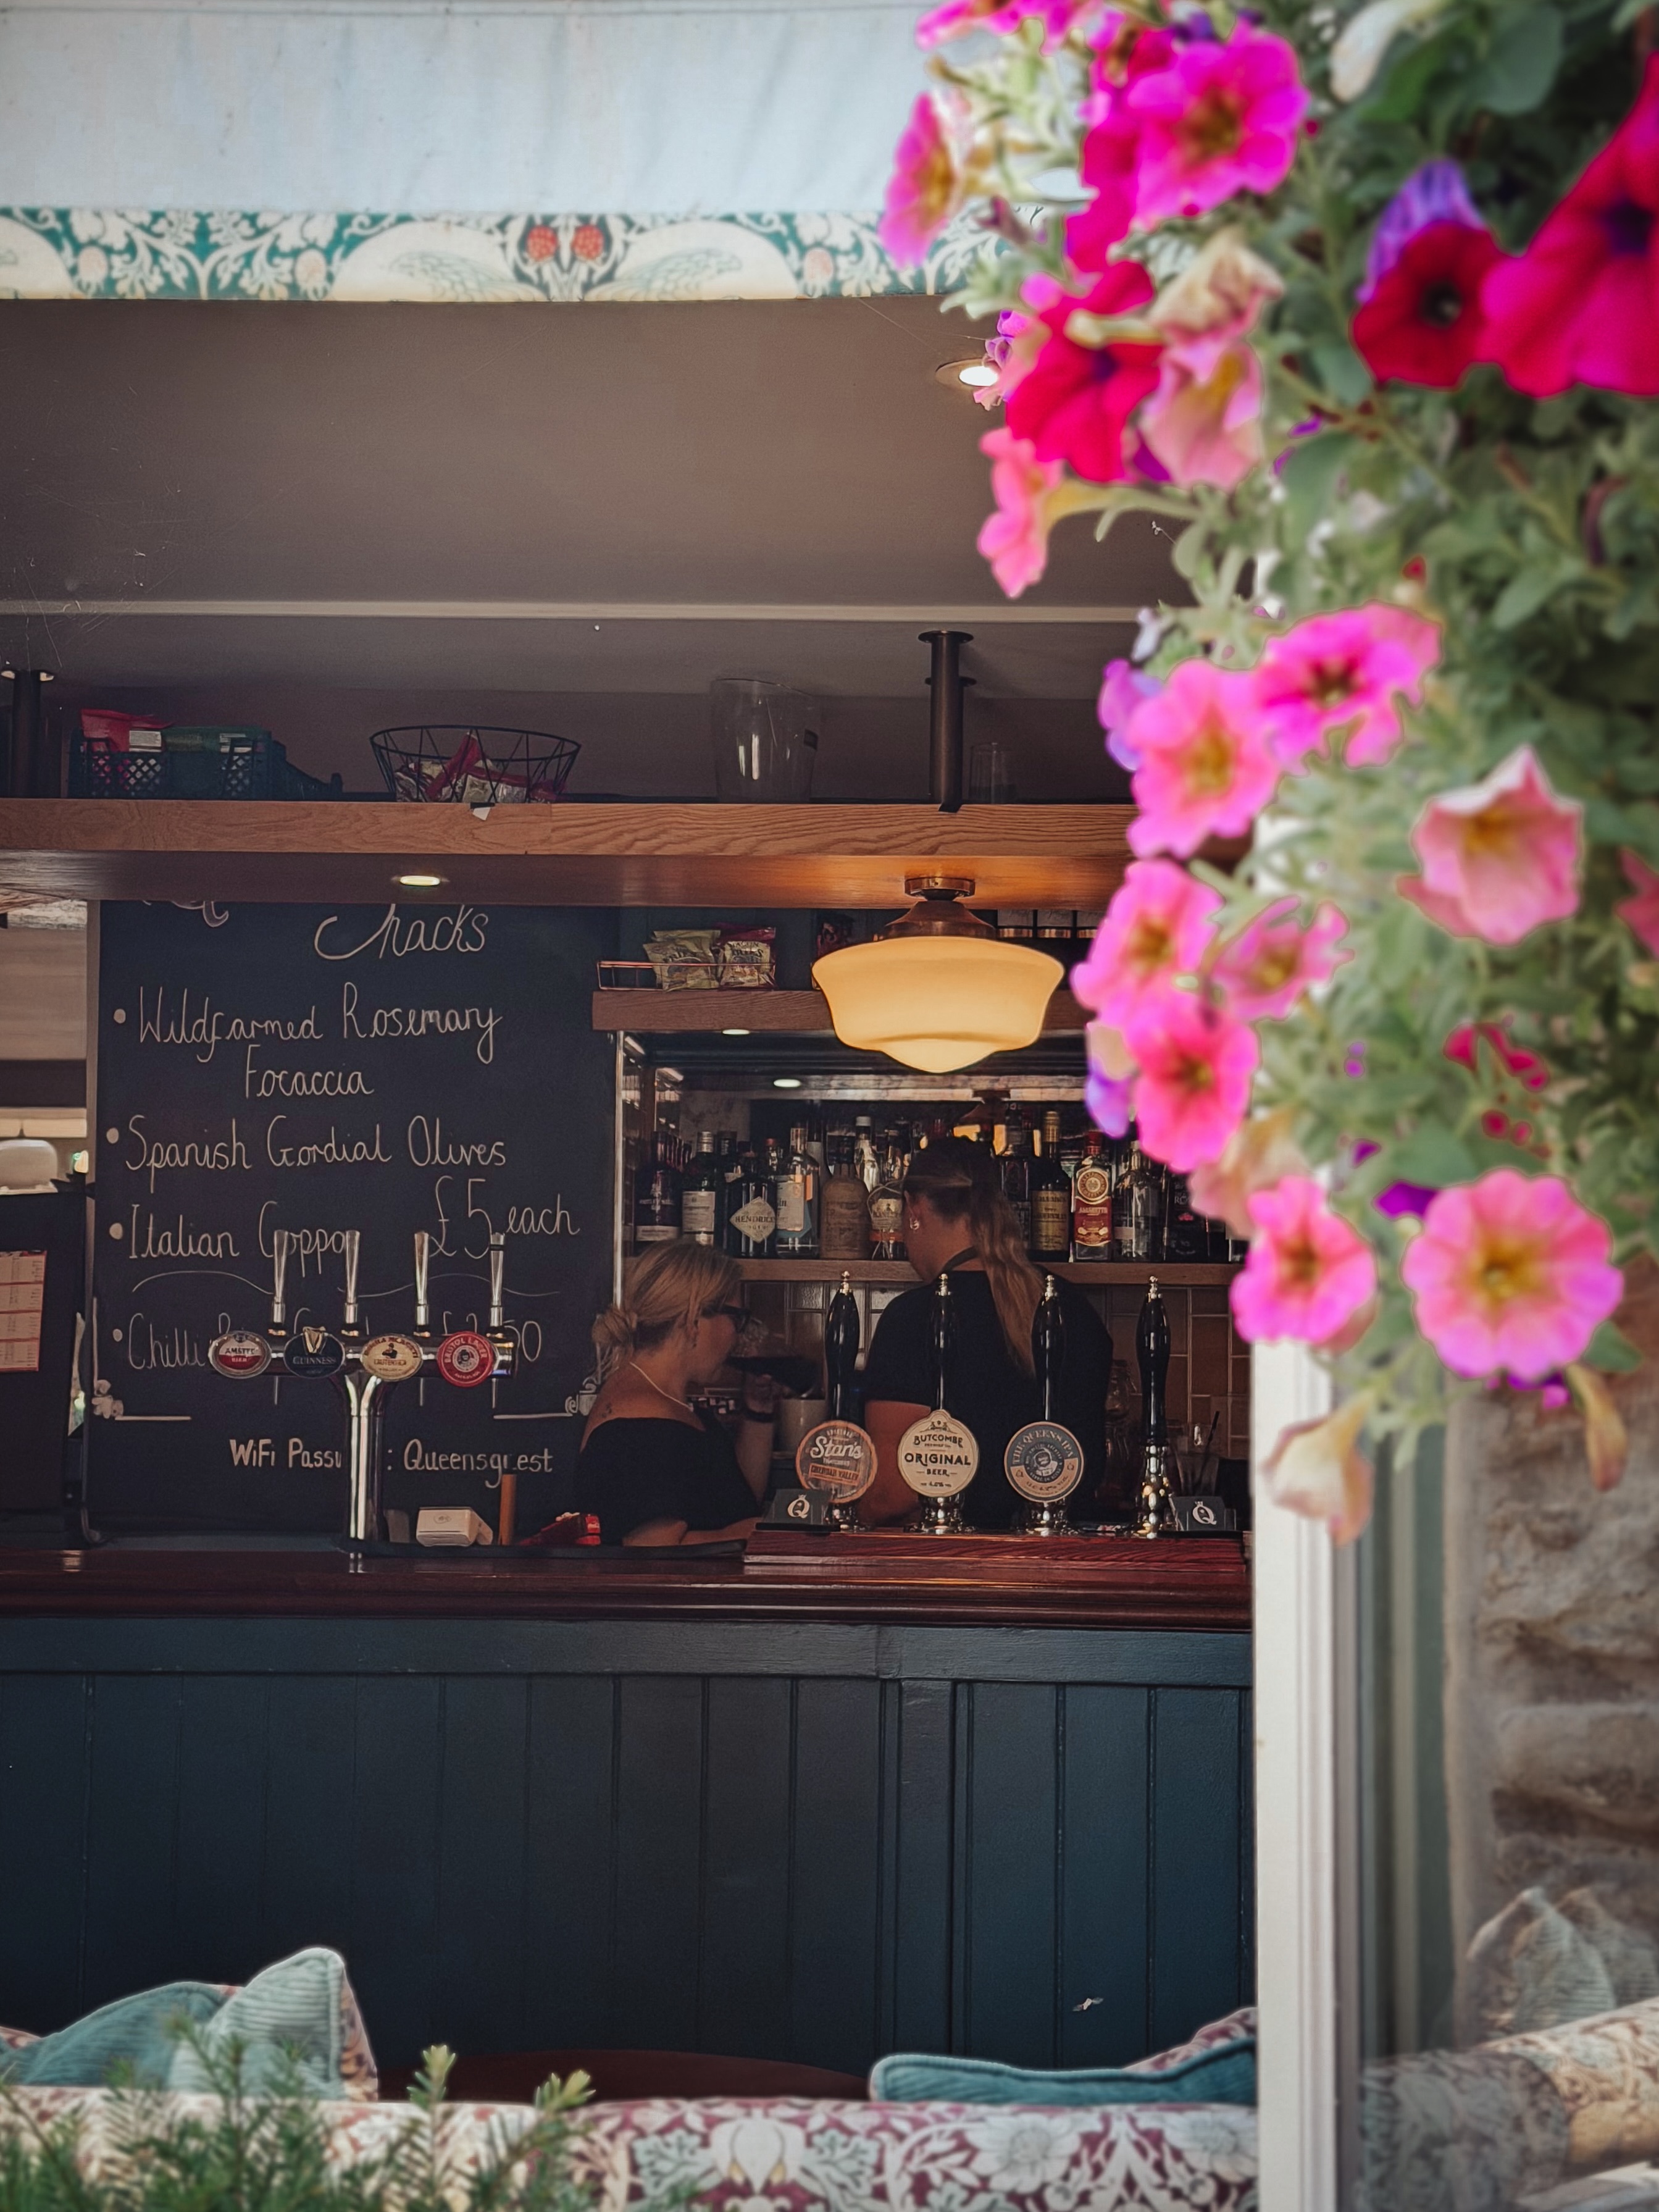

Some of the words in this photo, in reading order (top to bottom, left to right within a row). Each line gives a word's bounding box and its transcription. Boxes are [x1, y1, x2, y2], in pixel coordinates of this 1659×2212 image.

[140, 986, 324, 1063] Wildfarmed
[343, 982, 503, 1064] Rosemary
[245, 1044, 375, 1099] Focaccia
[125, 1114, 253, 1193] Spanish
[407, 1115, 506, 1166] Olives
[129, 1204, 240, 1258] Italian
[505, 1194, 580, 1234] each
[128, 1312, 206, 1370] Chilli
[293, 1356, 336, 1365] GUINNESS
[229, 1438, 275, 1468] WiFi
[810, 1436, 864, 1459] Stan's
[914, 1434, 964, 1448] BUTCOMBE
[904, 1452, 972, 1467] ORIGINAL
[926, 1468, 950, 1477] BEER
